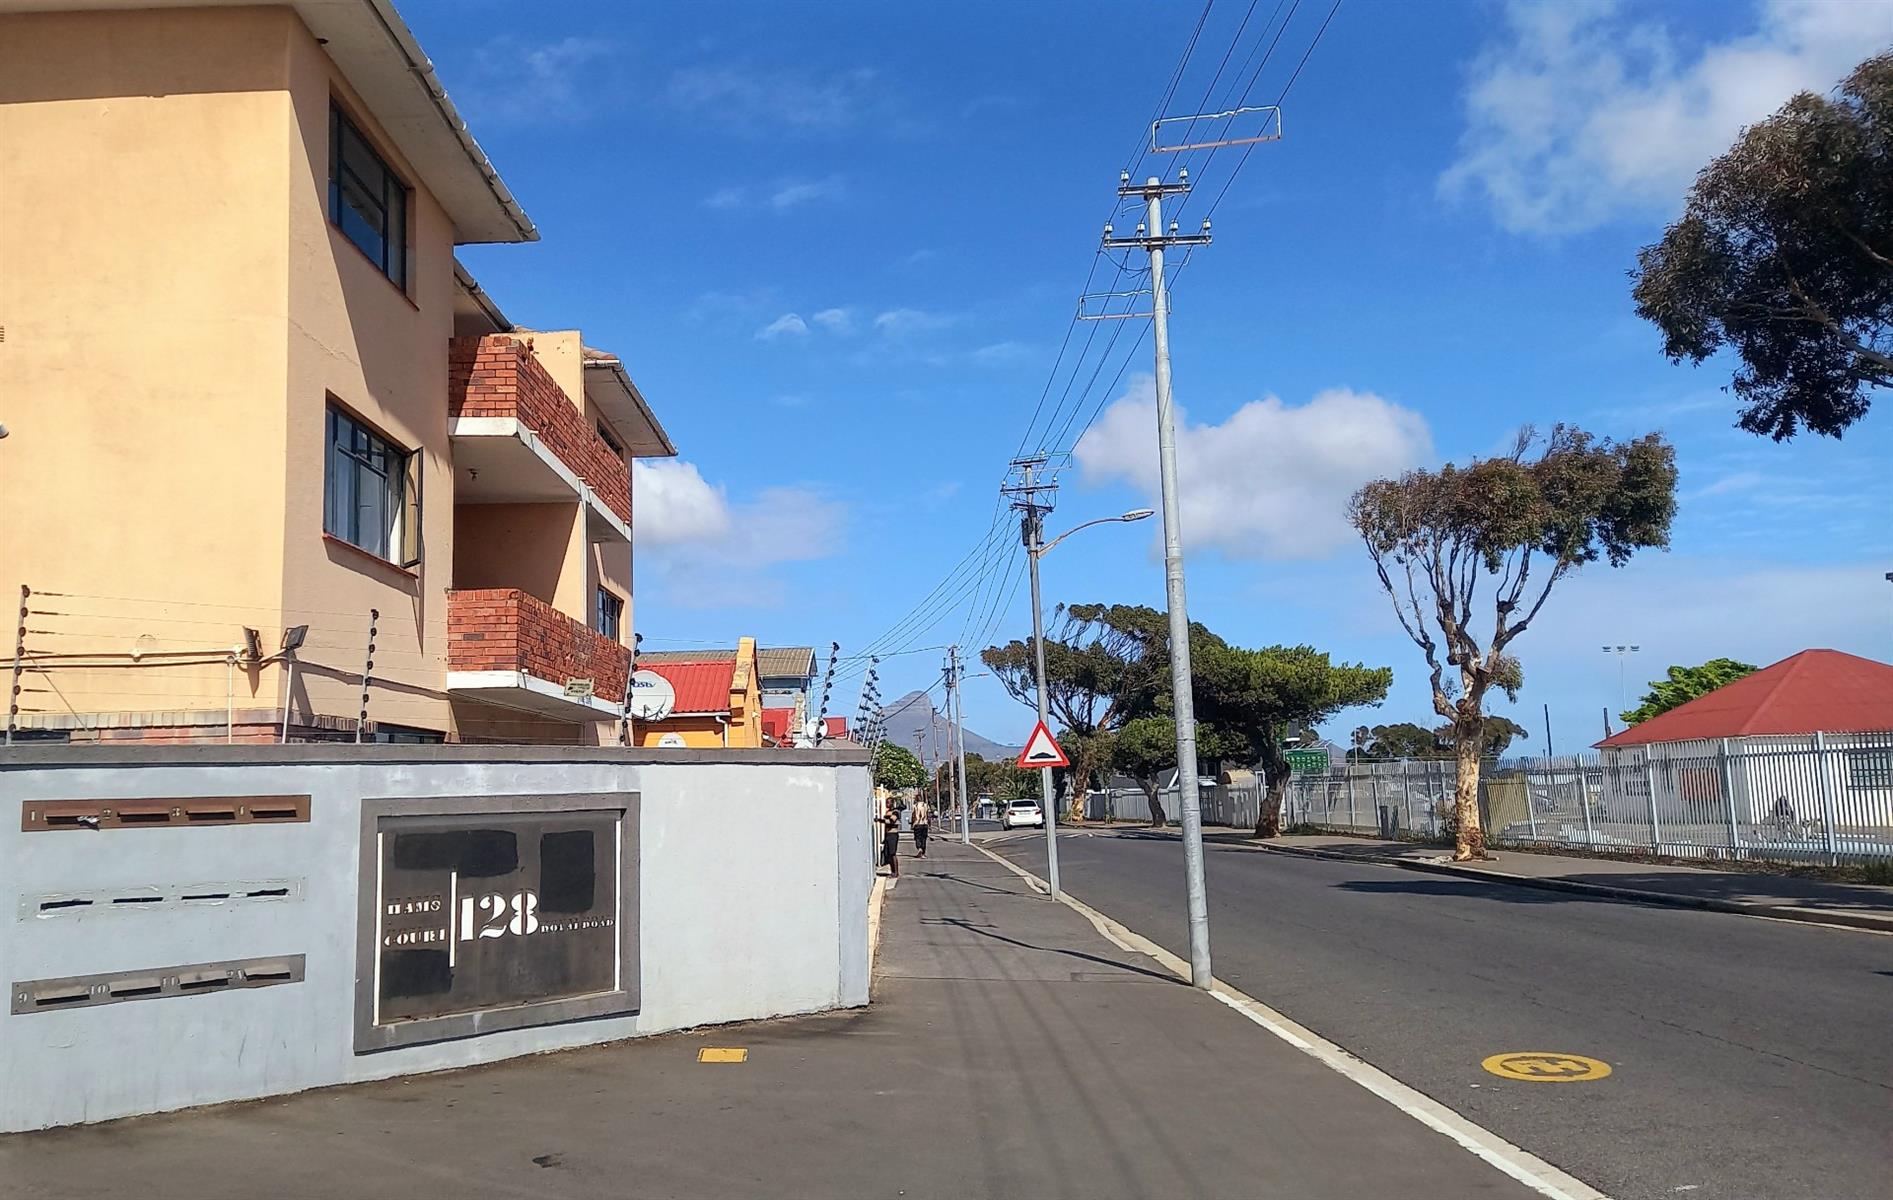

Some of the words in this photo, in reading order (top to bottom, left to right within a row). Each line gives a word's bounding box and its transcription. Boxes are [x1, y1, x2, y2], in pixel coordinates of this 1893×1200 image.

[460, 892, 538, 942] 128
[19, 992, 28, 1003] 9
[91, 984, 106, 995] 10
